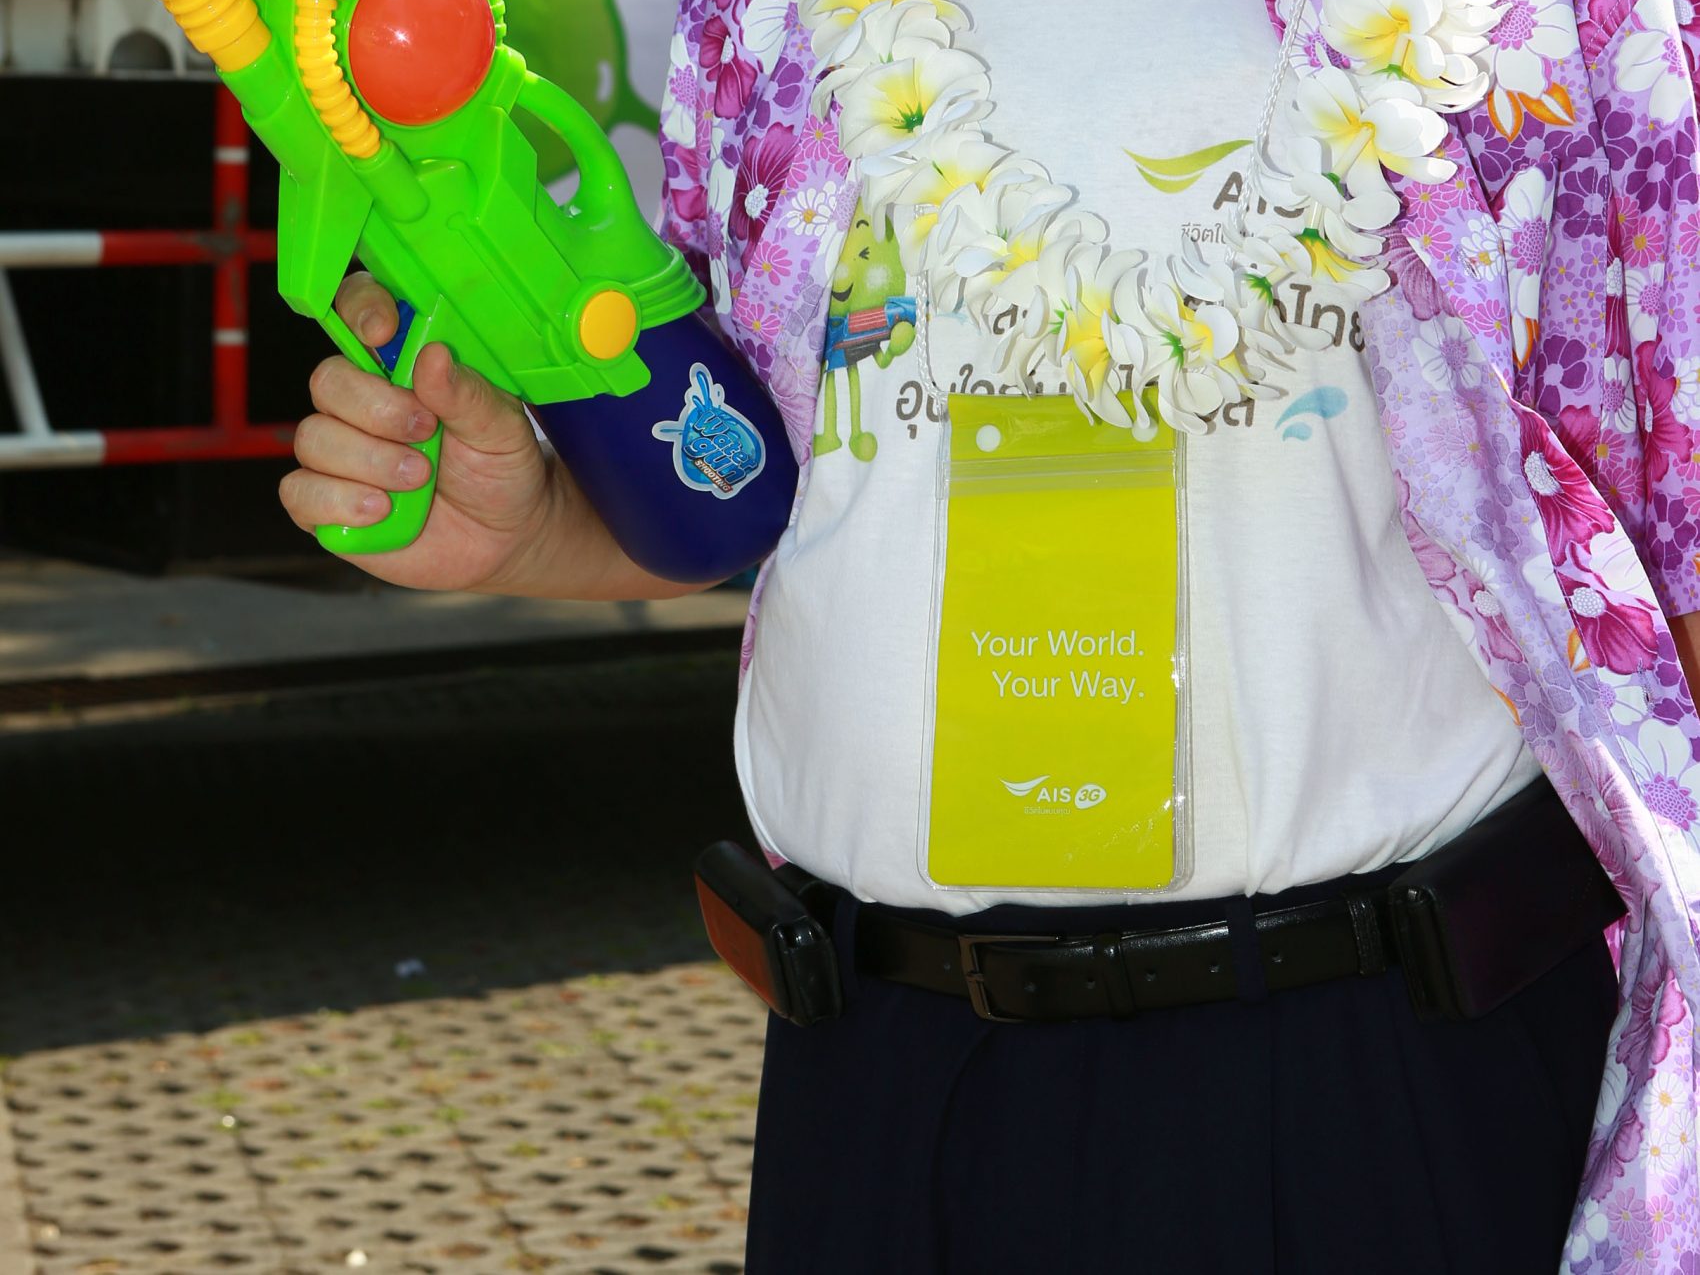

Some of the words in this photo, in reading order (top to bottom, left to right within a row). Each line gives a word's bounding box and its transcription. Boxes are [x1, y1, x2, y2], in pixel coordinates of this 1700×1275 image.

[693, 411, 758, 471] Water
[683, 437, 747, 485] gun
[694, 458, 731, 492] SHOOTING
[971, 630, 1039, 657] Your
[1047, 629, 1145, 657] World.
[991, 670, 1061, 698] Your
[1069, 670, 1145, 705] Way.
[1036, 786, 1072, 803] AIS
[1077, 787, 1102, 803] 3G
